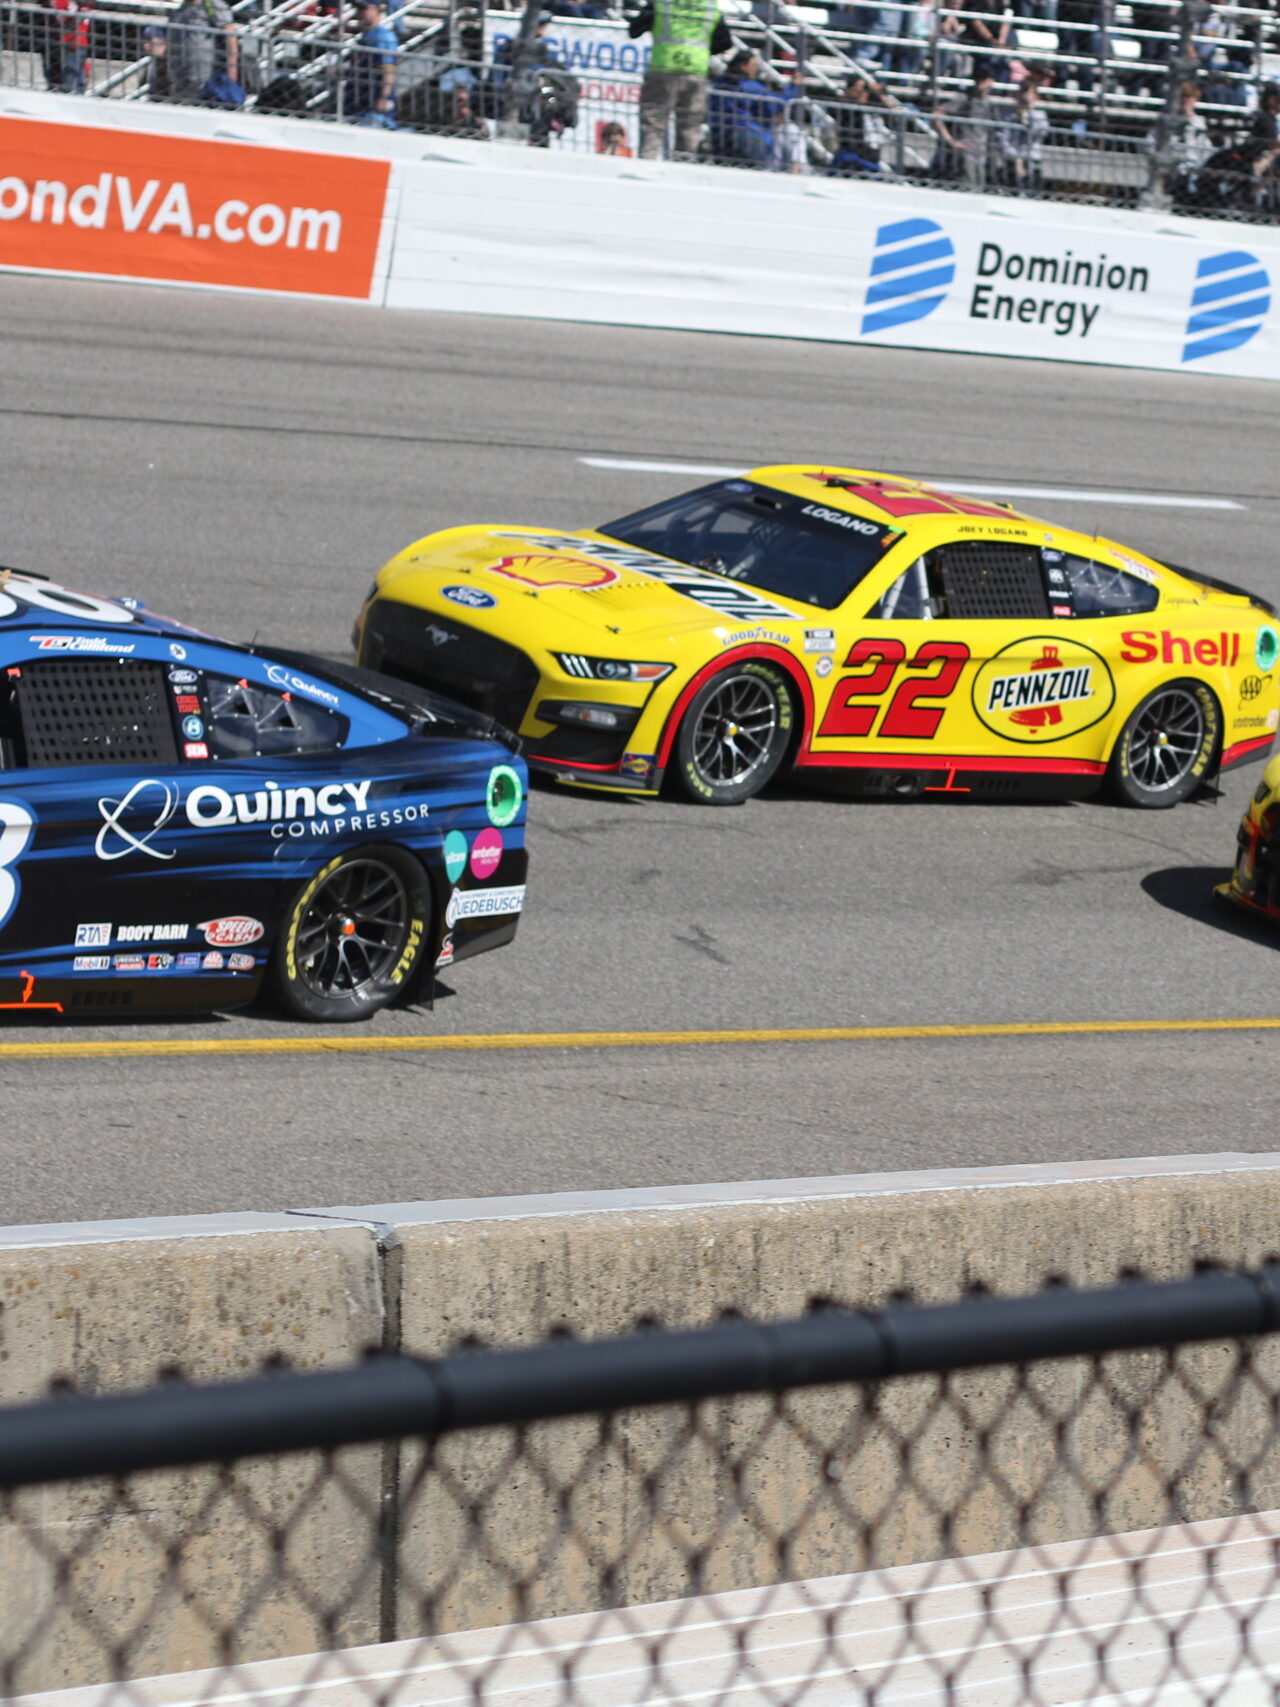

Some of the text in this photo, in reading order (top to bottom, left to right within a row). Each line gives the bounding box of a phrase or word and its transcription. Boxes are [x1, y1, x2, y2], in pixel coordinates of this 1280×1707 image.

[977, 242, 1149, 292] Dominion
[969, 284, 1100, 337] Energy
[801, 504, 879, 536] LOGANO
[957, 525, 1028, 537] JOEY LOGANO
[1120, 630, 1240, 667] Shell
[291, 677, 340, 703] Quincy
[816, 638, 971, 740] 22
[988, 667, 1093, 711] PENNZOIL
[270, 803, 430, 838] COMPRESSOR
[78, 924, 189, 943] RTA BOOT BARN
[216, 931, 255, 942] CASH
[218, 920, 258, 932] SPEEDY
[76, 958, 99, 968] Mobil
[391, 919, 424, 985] EAGLE
